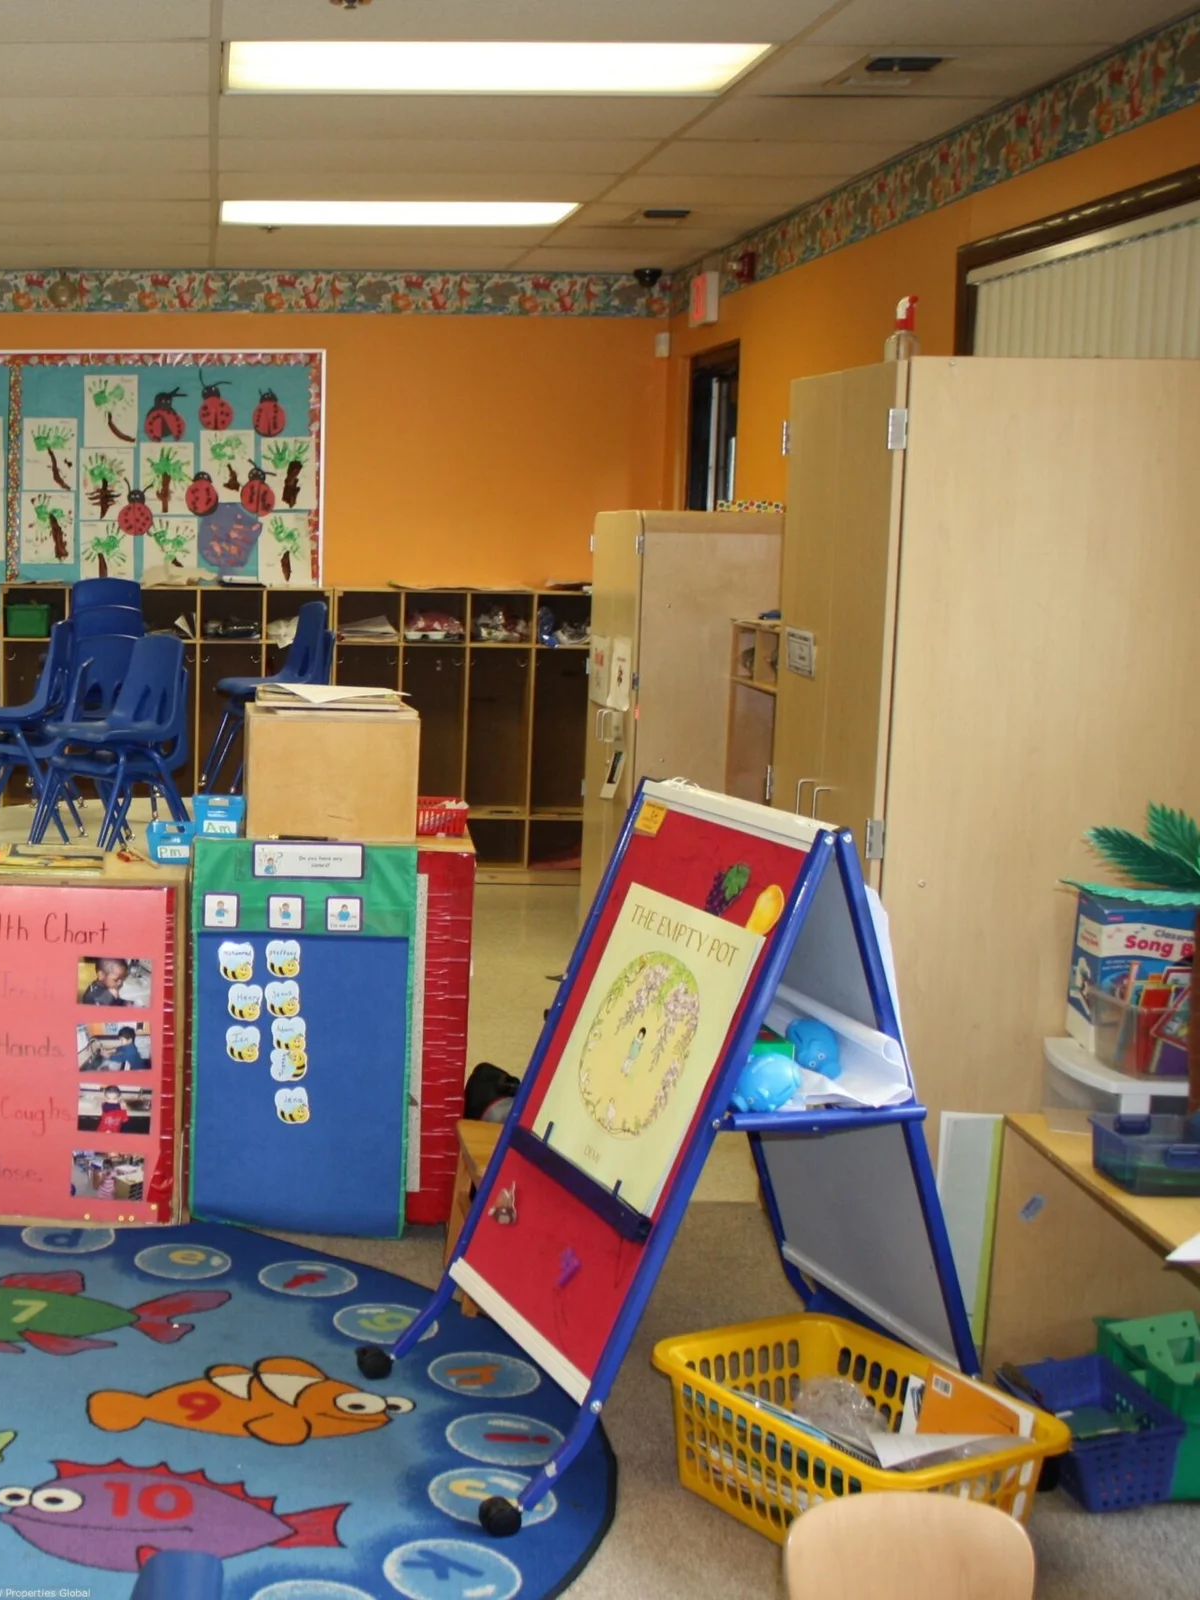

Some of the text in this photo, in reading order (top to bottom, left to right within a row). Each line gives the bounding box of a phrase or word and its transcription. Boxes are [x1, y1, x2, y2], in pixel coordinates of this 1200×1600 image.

[206, 822, 232, 834] Am
[44, 912, 109, 945] Chart
[631, 904, 739, 967] THE EMPTY POT
[1125, 935, 1174, 958] Song
[43, 1228, 83, 1248] d
[168, 1250, 206, 1265] e
[11, 1300, 48, 1323] 7
[177, 1391, 222, 1421] 9
[103, 1482, 194, 1520] 10
